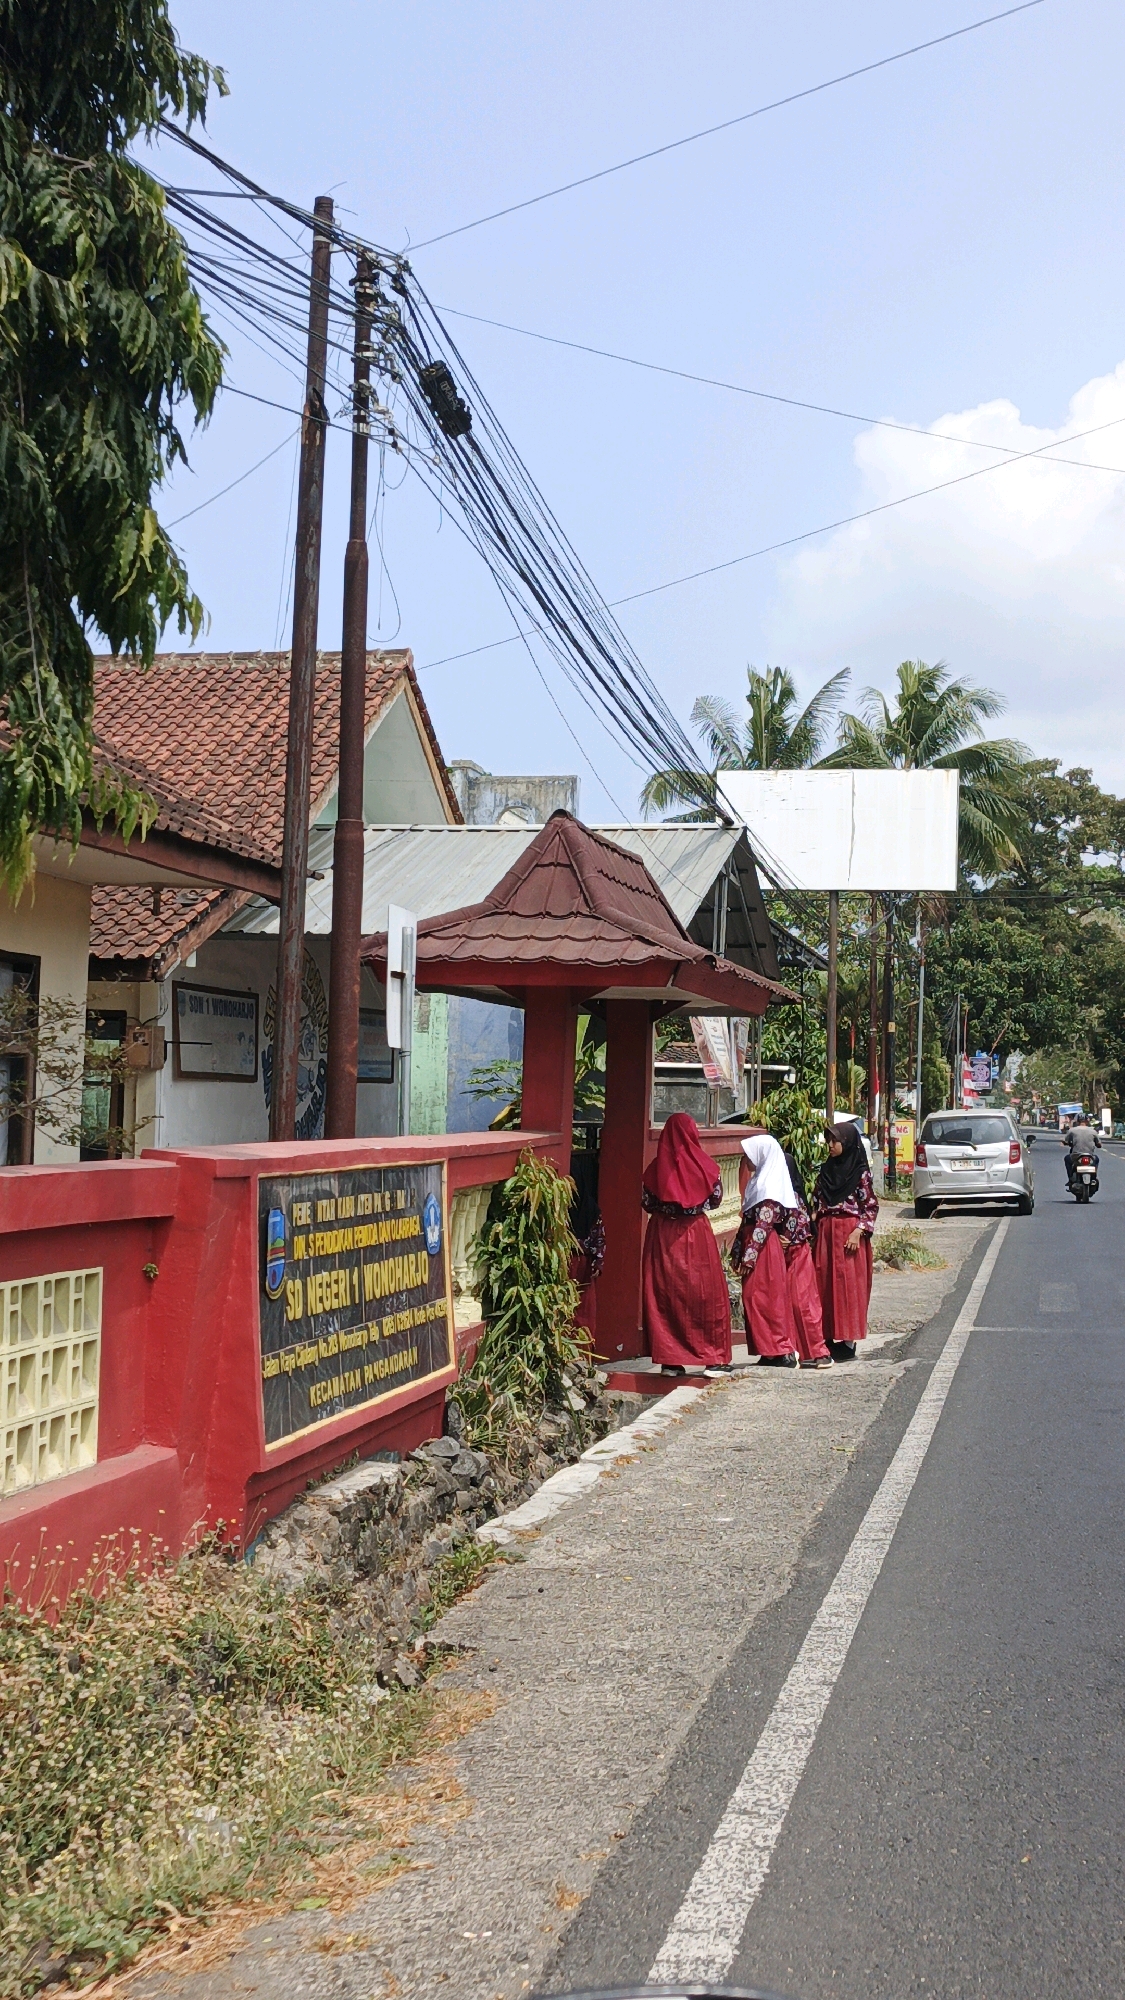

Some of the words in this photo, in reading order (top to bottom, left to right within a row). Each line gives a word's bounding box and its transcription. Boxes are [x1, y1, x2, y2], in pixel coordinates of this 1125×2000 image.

[205, 997, 210, 1016] 1
[293, 1234, 315, 1261] DINS
[286, 1279, 303, 1321] SD
[307, 1268, 350, 1317] NEGERI
[352, 1267, 360, 1304] 1
[363, 1251, 429, 1301] WONOHARJO
[309, 1368, 362, 1408] KECAMATAN
[364, 1346, 418, 1385] PANGANDARAN
